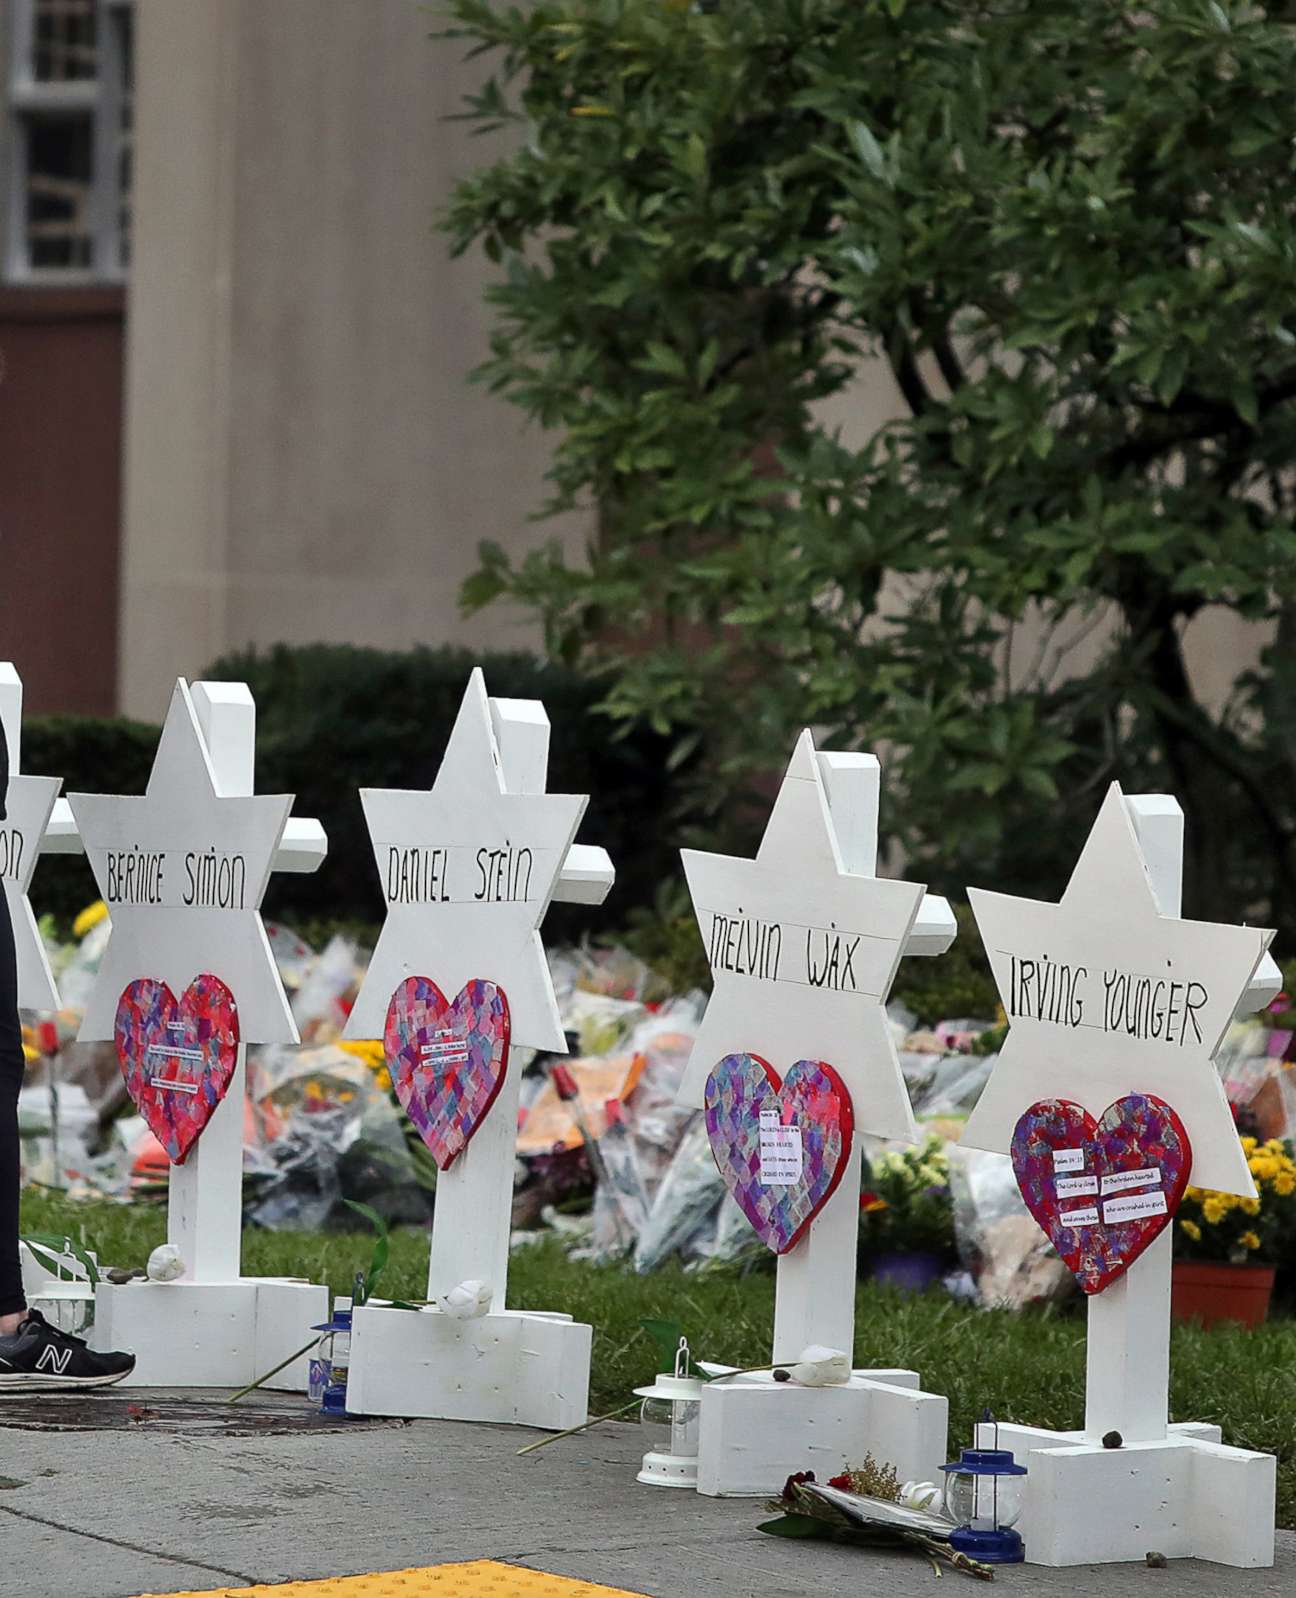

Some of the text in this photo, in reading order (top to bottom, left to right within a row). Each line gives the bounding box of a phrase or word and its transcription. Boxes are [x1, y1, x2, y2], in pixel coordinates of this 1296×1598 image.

[107, 851, 245, 910] BERNICE SIMON
[388, 847, 532, 904] DANIEL STEIN
[709, 913, 861, 991] MELVIN WAX
[1010, 955, 1209, 1047] IRVING YOUNGER
[35, 1343, 73, 1374] N
